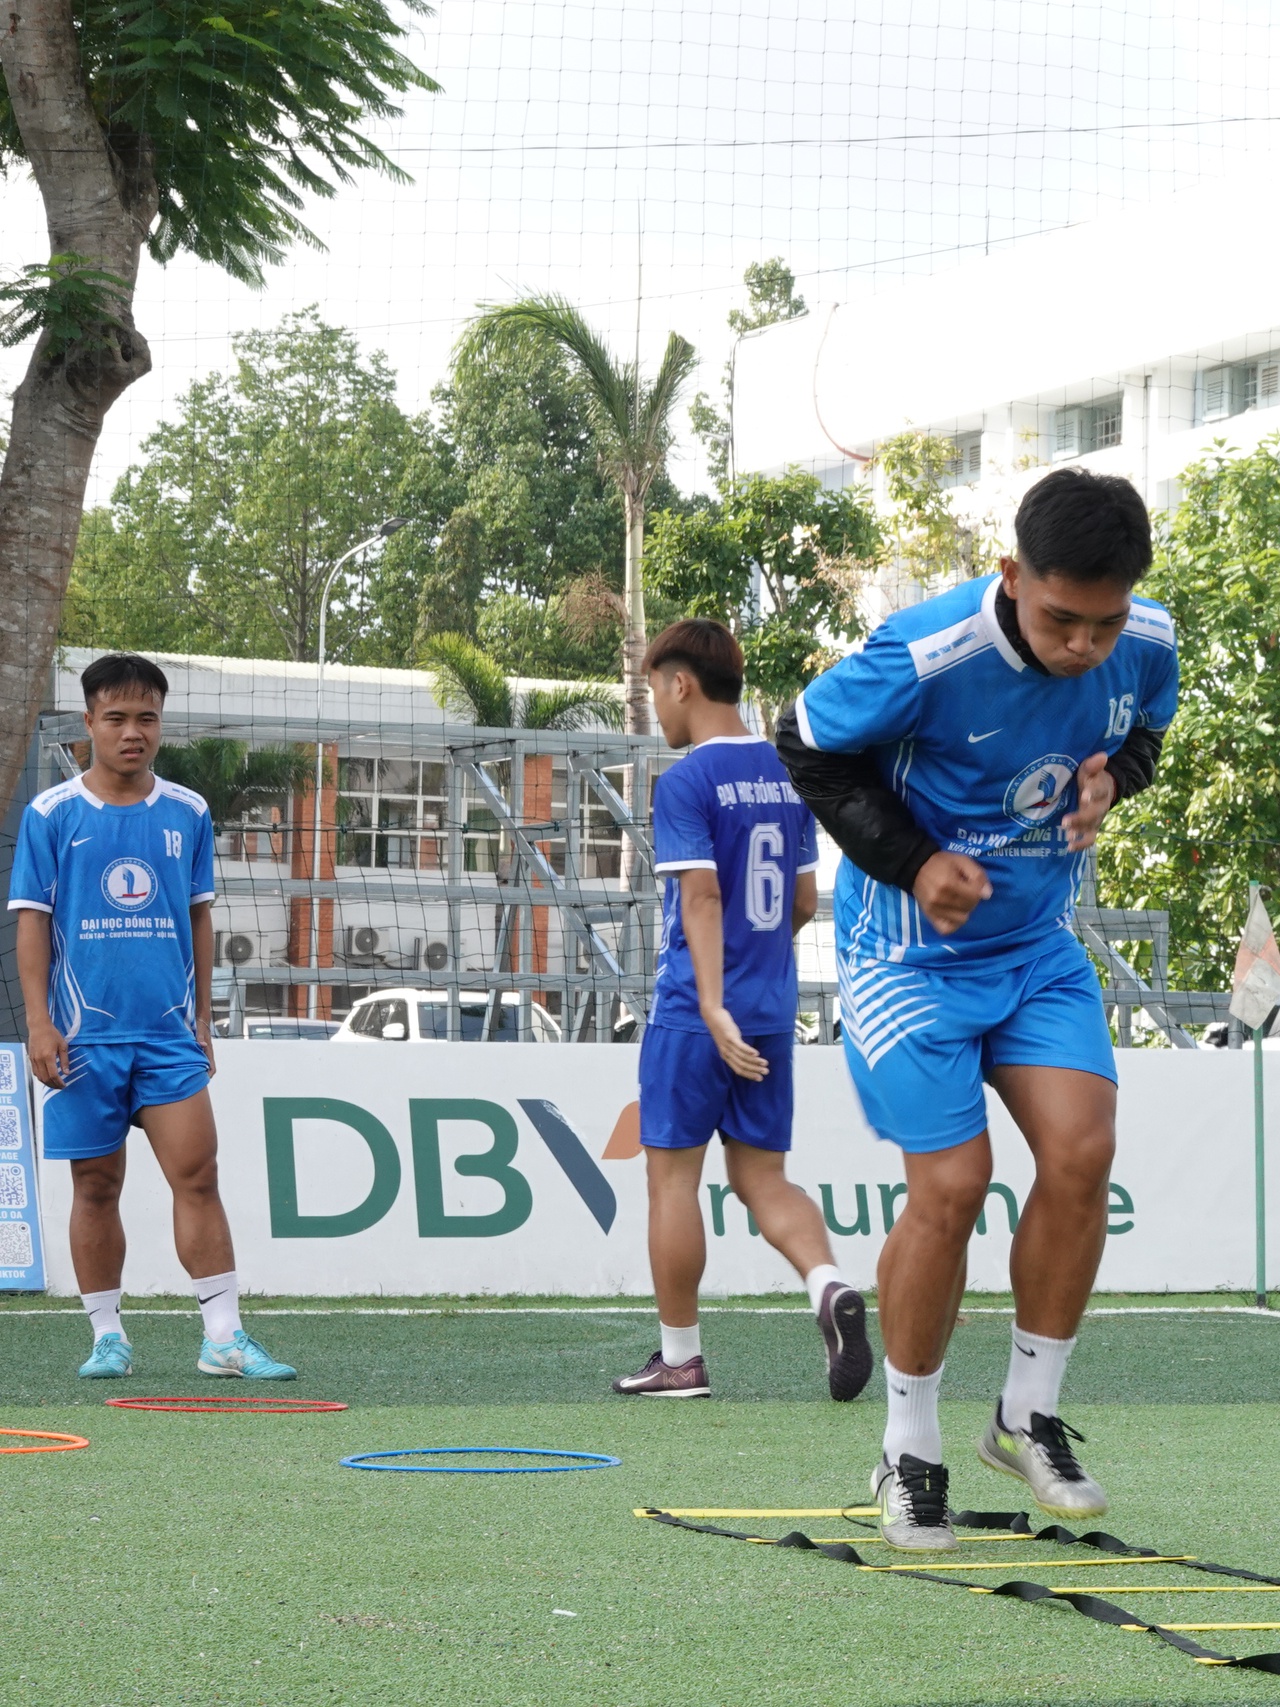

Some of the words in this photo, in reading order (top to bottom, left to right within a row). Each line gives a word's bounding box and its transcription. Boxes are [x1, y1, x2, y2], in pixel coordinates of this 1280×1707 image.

[1104, 693, 1134, 739] 16
[163, 829, 182, 859] 18
[745, 823, 784, 931] 6
[81, 918, 99, 932] ĐẠI
[102, 918, 123, 931] HỌC
[154, 916, 175, 929] THÁ
[263, 1097, 642, 1238] DBV
